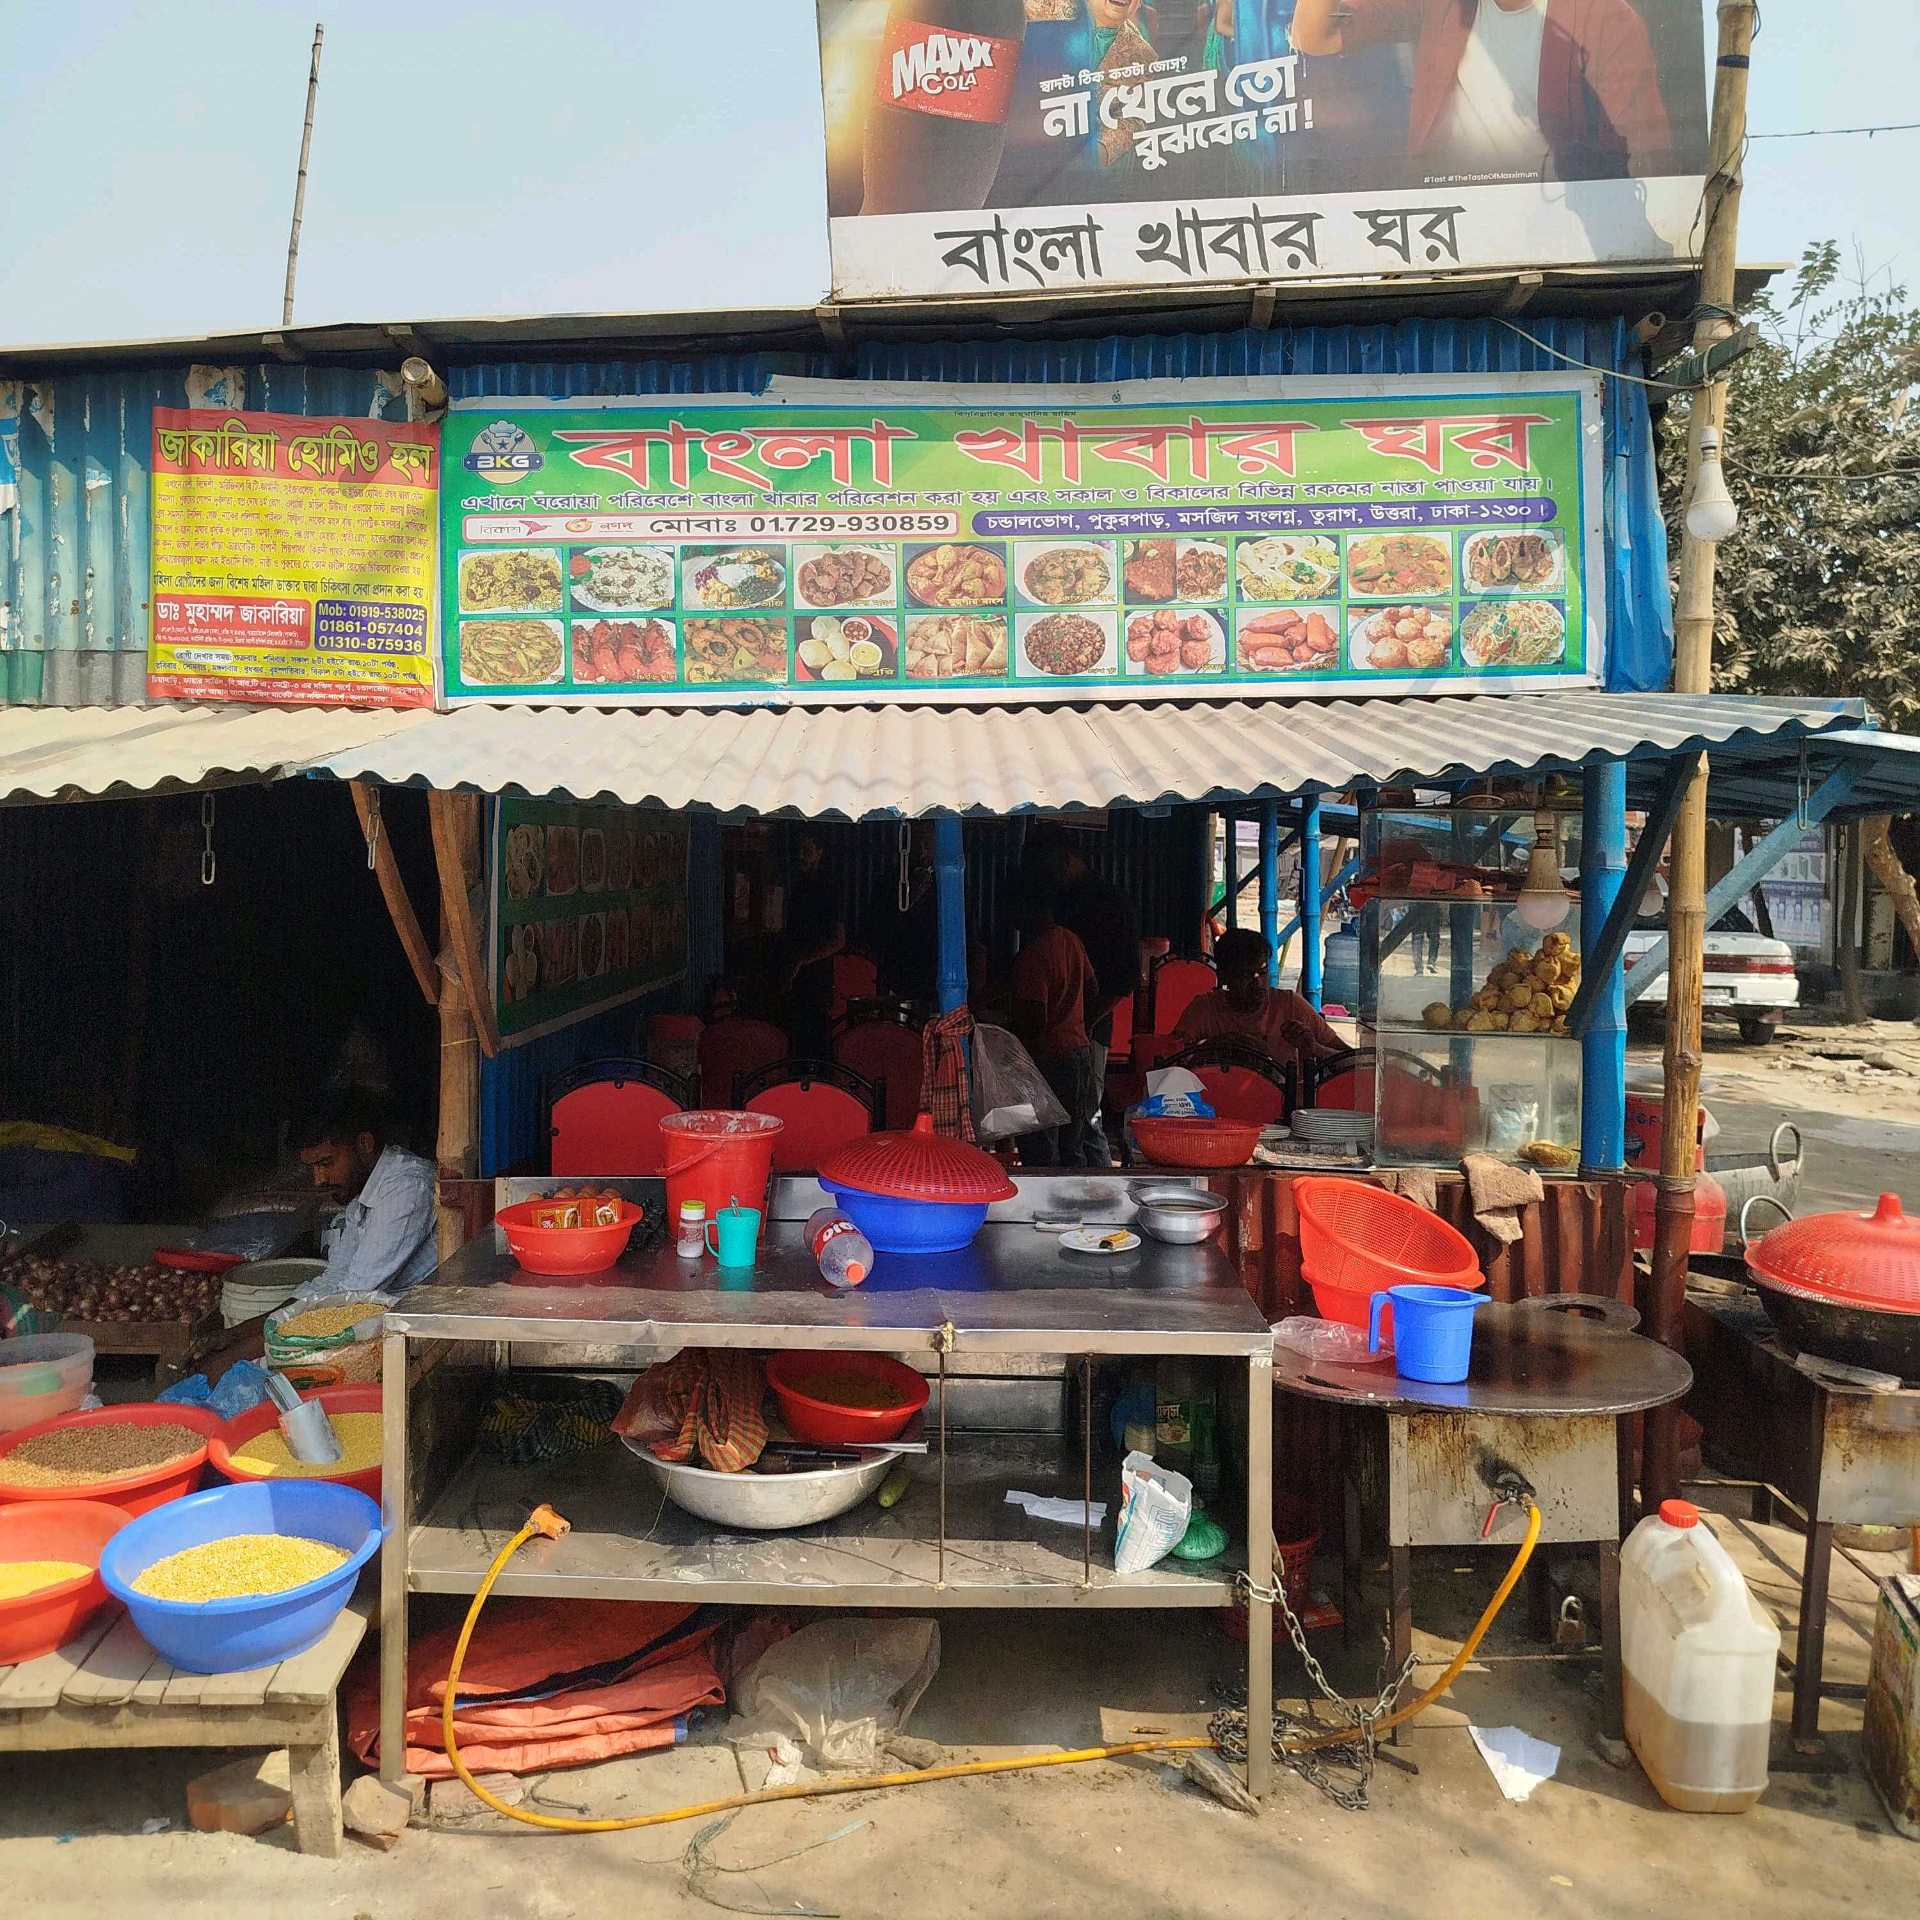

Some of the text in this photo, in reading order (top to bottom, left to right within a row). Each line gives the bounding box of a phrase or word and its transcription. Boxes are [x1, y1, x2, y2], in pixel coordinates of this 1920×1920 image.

[892, 34, 994, 100] MAXX
[1039, 74, 1075, 92] স্বাদটা
[1079, 68, 1104, 87] ঠিক
[1109, 62, 1145, 82] কতটা
[921, 72, 978, 96] COLA
[1040, 55, 1299, 137] না খেলে তো
[1133, 110, 1258, 170] বুঝবেন
[934, 202, 1468, 287] বাংলা খাবার ঘর
[156, 418, 436, 483] জাকারিয়া হোমিও হল
[475, 453, 531, 470] BKG
[552, 413, 1555, 491] বাংলা খাবার ঘর
[461, 494, 526, 511] এখানে
[535, 492, 600, 511] ঘরোয়া
[607, 490, 693, 510] পরিবেশে
[700, 492, 756, 508] বাংলা
[764, 490, 820, 508] খাবার
[826, 489, 920, 508] পরিবেশন
[924, 491, 965, 507] করা
[972, 491, 1000, 506] হয়
[1006, 489, 1052, 506] এবং
[1055, 487, 1114, 504] সকাল
[1120, 488, 1139, 501] ও
[1145, 484, 1231, 501] বিকালের
[1238, 482, 1297, 501] বিভিন্ন
[1302, 480, 1373, 498] রকমের
[1381, 479, 1426, 497] নাস্তা
[1433, 478, 1496, 495] পাওয়া
[598, 521, 635, 530] নগদ
[650, 517, 737, 534] মোবাঃ
[1177, 508, 1240, 526] মসজিদ
[1309, 506, 1364, 526] তুরাগ,
[227, 573, 249, 590] বিশেষ
[252, 575, 275, 592] মহিলা
[320, 577, 351, 596] চিকিৎসা
[353, 583, 371, 597] সেবা
[373, 584, 393, 598] প্রদান
[395, 585, 411, 599] করা
[156, 600, 306, 627] ডাঃ মুহাম্মদ জাকারিয়া
[318, 602, 426, 622] Mob: 01919-538025
[319, 619, 424, 638] 01861-057404
[318, 634, 424, 653] 01310-875936
